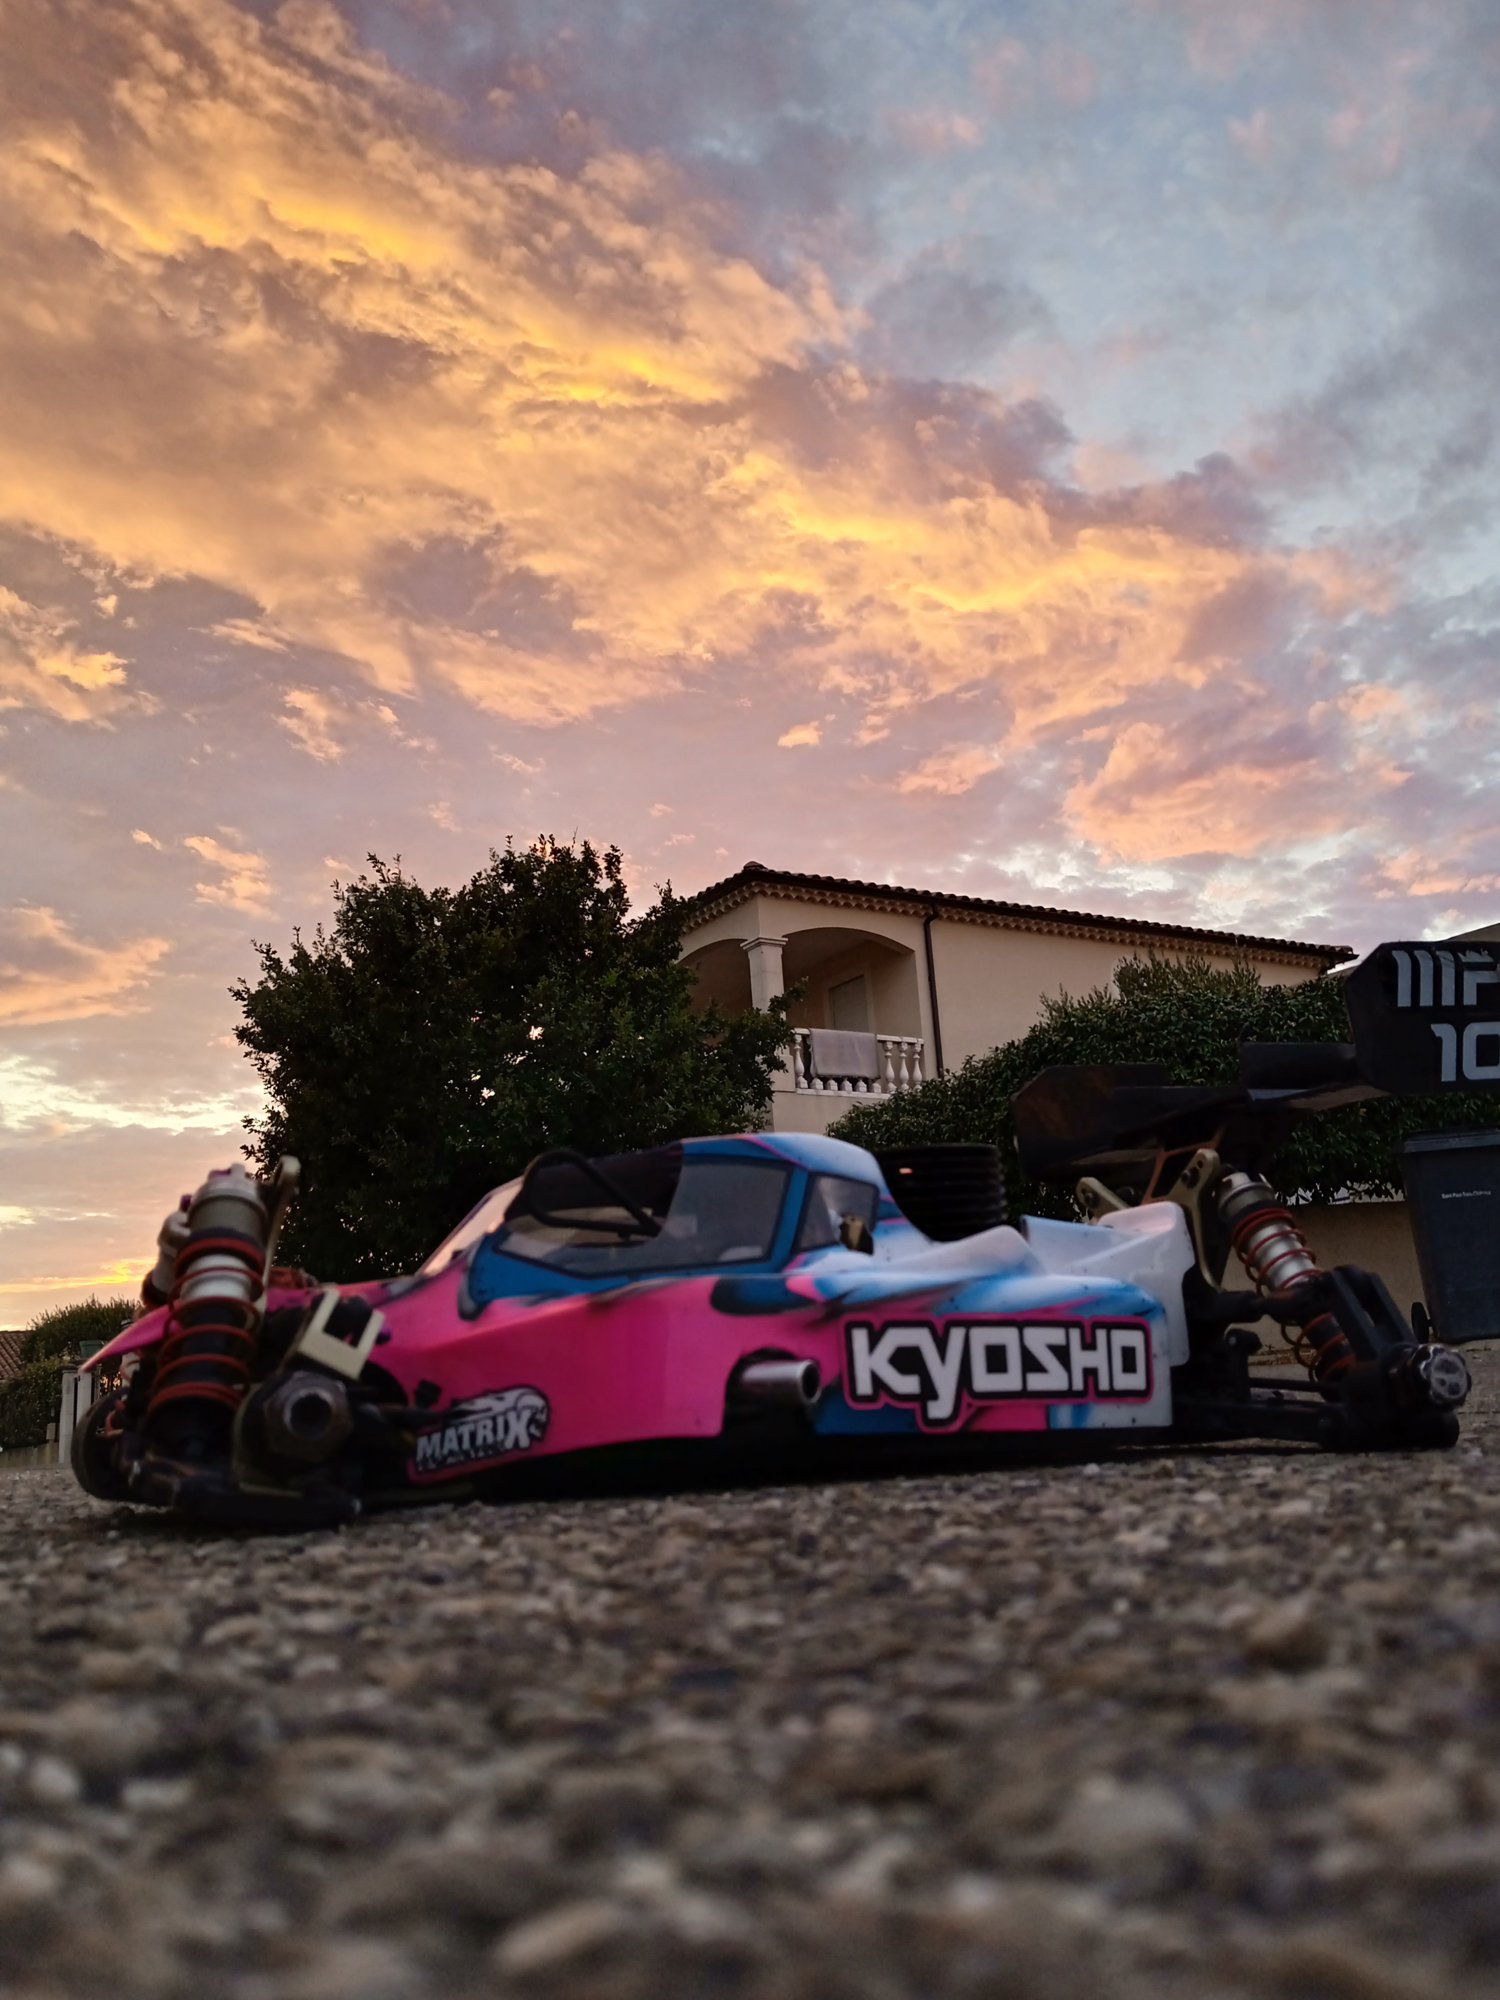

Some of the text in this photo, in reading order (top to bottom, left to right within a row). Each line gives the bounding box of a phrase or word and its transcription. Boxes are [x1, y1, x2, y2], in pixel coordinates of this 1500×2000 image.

[1430, 1021, 1500, 1081] 10
[851, 1326, 1147, 1420] KYOSHO
[416, 1409, 531, 1463] MATRIX
